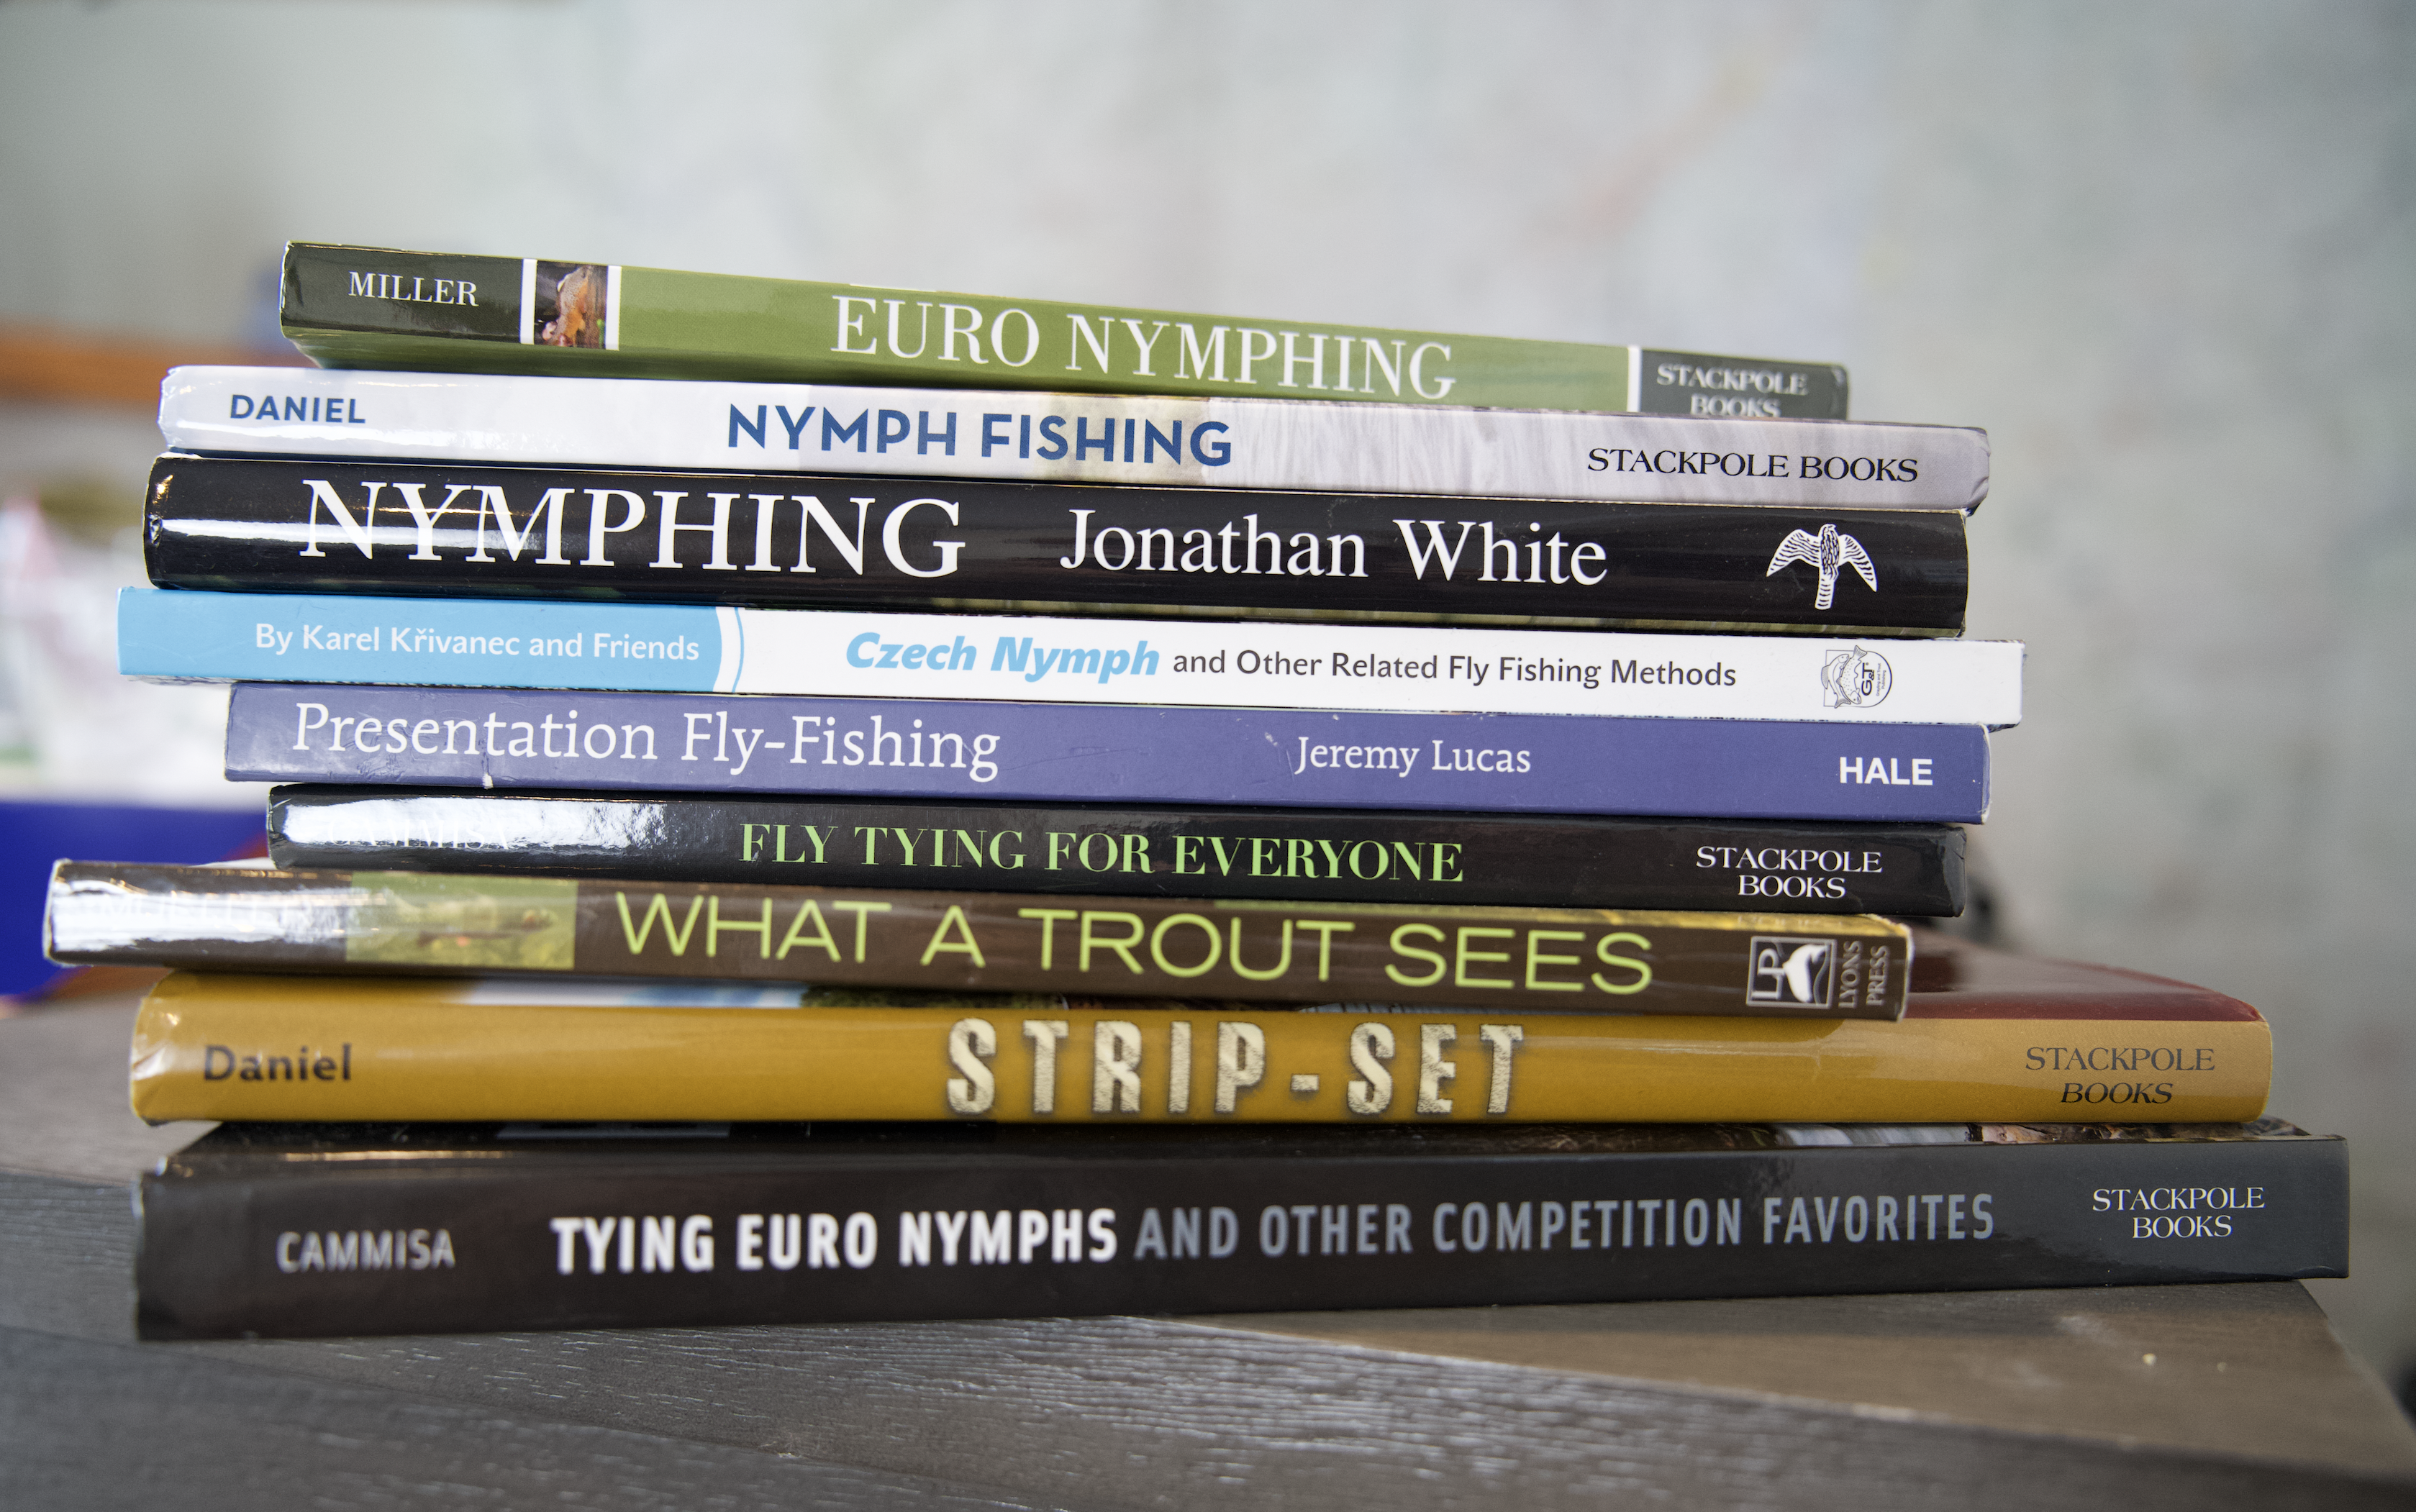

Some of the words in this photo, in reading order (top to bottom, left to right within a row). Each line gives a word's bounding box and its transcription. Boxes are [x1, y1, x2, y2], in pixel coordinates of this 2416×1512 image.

[348, 271, 478, 306] MILLER
[830, 295, 1040, 367] EURO
[1066, 314, 1457, 400] NYMPHING
[1656, 363, 1808, 396] STACKPOLE
[230, 393, 365, 424] DANIEL
[1691, 393, 1781, 417] BOOKS
[728, 404, 957, 456] NYMPH
[981, 413, 1232, 467] FISHING
[1586, 447, 1790, 478] STACKPOLE
[1799, 455, 1919, 483] BOOKS
[299, 478, 967, 578] NYMPHING
[1060, 509, 1368, 577] Jonathan
[1392, 519, 1607, 586] White
[256, 623, 294, 656] By
[303, 624, 380, 652] Karel
[391, 627, 520, 656] Křivanec
[529, 632, 583, 657] and
[594, 632, 699, 661] Friends
[846, 632, 977, 670] Czech
[990, 636, 1160, 684] Nymph
[1173, 649, 1225, 674] and
[1236, 649, 1322, 676] Other
[1332, 652, 1438, 679] Related
[1449, 655, 1489, 687] Fly
[1499, 656, 1602, 690] Fishing
[1611, 659, 1736, 687] Methods
[291, 702, 658, 767] Presentation
[681, 711, 1001, 783] Fly-Fishing
[1294, 736, 1420, 778] Jeremy
[1432, 739, 1531, 773] Lucas
[1840, 756, 1933, 785] HALE
[740, 823, 837, 864] FLY
[854, 826, 1025, 869] TYING
[1045, 832, 1152, 873] FOR
[1173, 835, 1463, 882] EVERYONE
[1696, 846, 1883, 873] STACKPOLE
[1738, 875, 1846, 898] BOOKS
[614, 891, 892, 965] WHAT
[921, 905, 985, 967] A
[1018, 908, 1355, 981] TROUT
[1385, 923, 1652, 994] SEES
[1838, 940, 1862, 1008] LYONS
[1866, 945, 1889, 1006] PRESS
[202, 1044, 353, 1083] Daniel
[2025, 1047, 2216, 1072] STACKPOLE
[2060, 1081, 2174, 1105] BOOKS
[2092, 1187, 2265, 1211] STACKPOLE
[550, 1215, 714, 1274] TYING
[737, 1212, 877, 1270] EURO
[899, 1208, 1117, 1266] NYMPHS
[1134, 1207, 1238, 1259] AND
[1260, 1203, 1412, 1257] OTHER
[1433, 1198, 1741, 1252] COMPETITION
[1763, 1193, 1994, 1244] FAVORITES
[2133, 1215, 2233, 1239] BOOKS
[277, 1229, 455, 1272] CAMMISA
